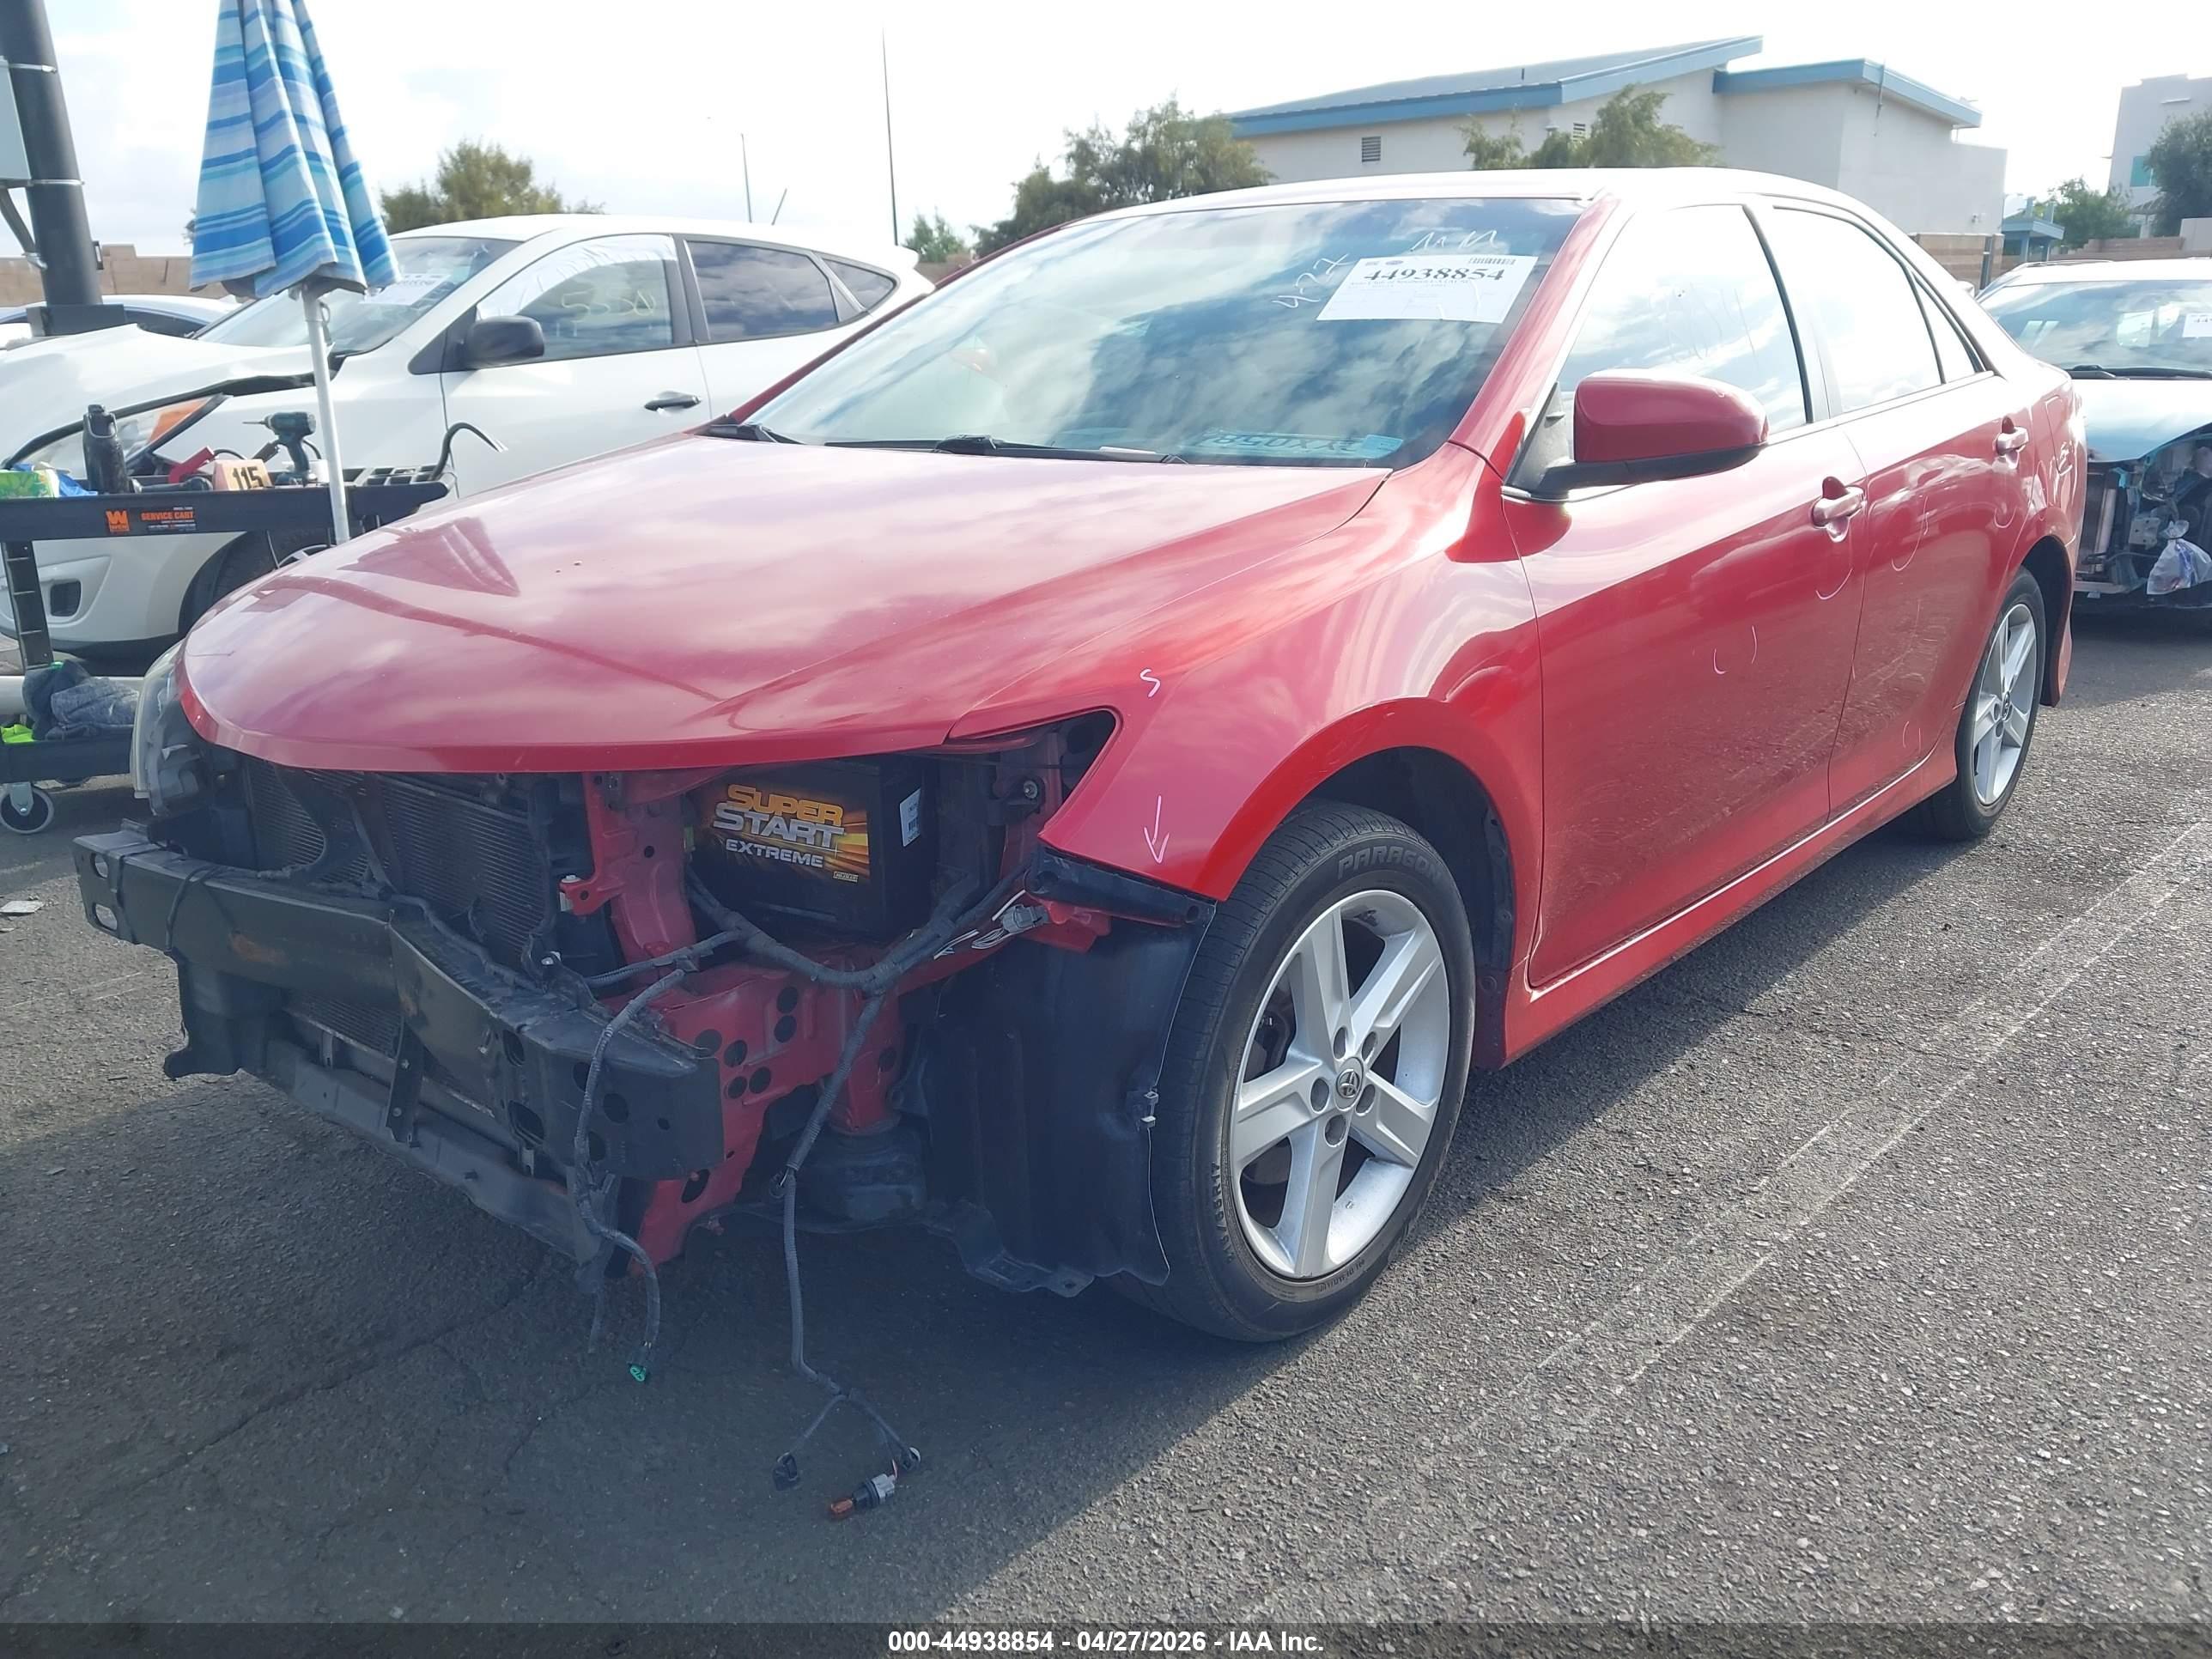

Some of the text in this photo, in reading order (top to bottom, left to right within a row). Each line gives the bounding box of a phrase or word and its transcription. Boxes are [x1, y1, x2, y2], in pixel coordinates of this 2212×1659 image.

[1364, 268, 1505, 281] 44938854
[233, 466, 264, 489] 115
[141, 511, 193, 520] SERVICE CART
[713, 800, 845, 848] START
[725, 839, 824, 868] EXTREME
[1338, 845, 1443, 884] PARAGON
